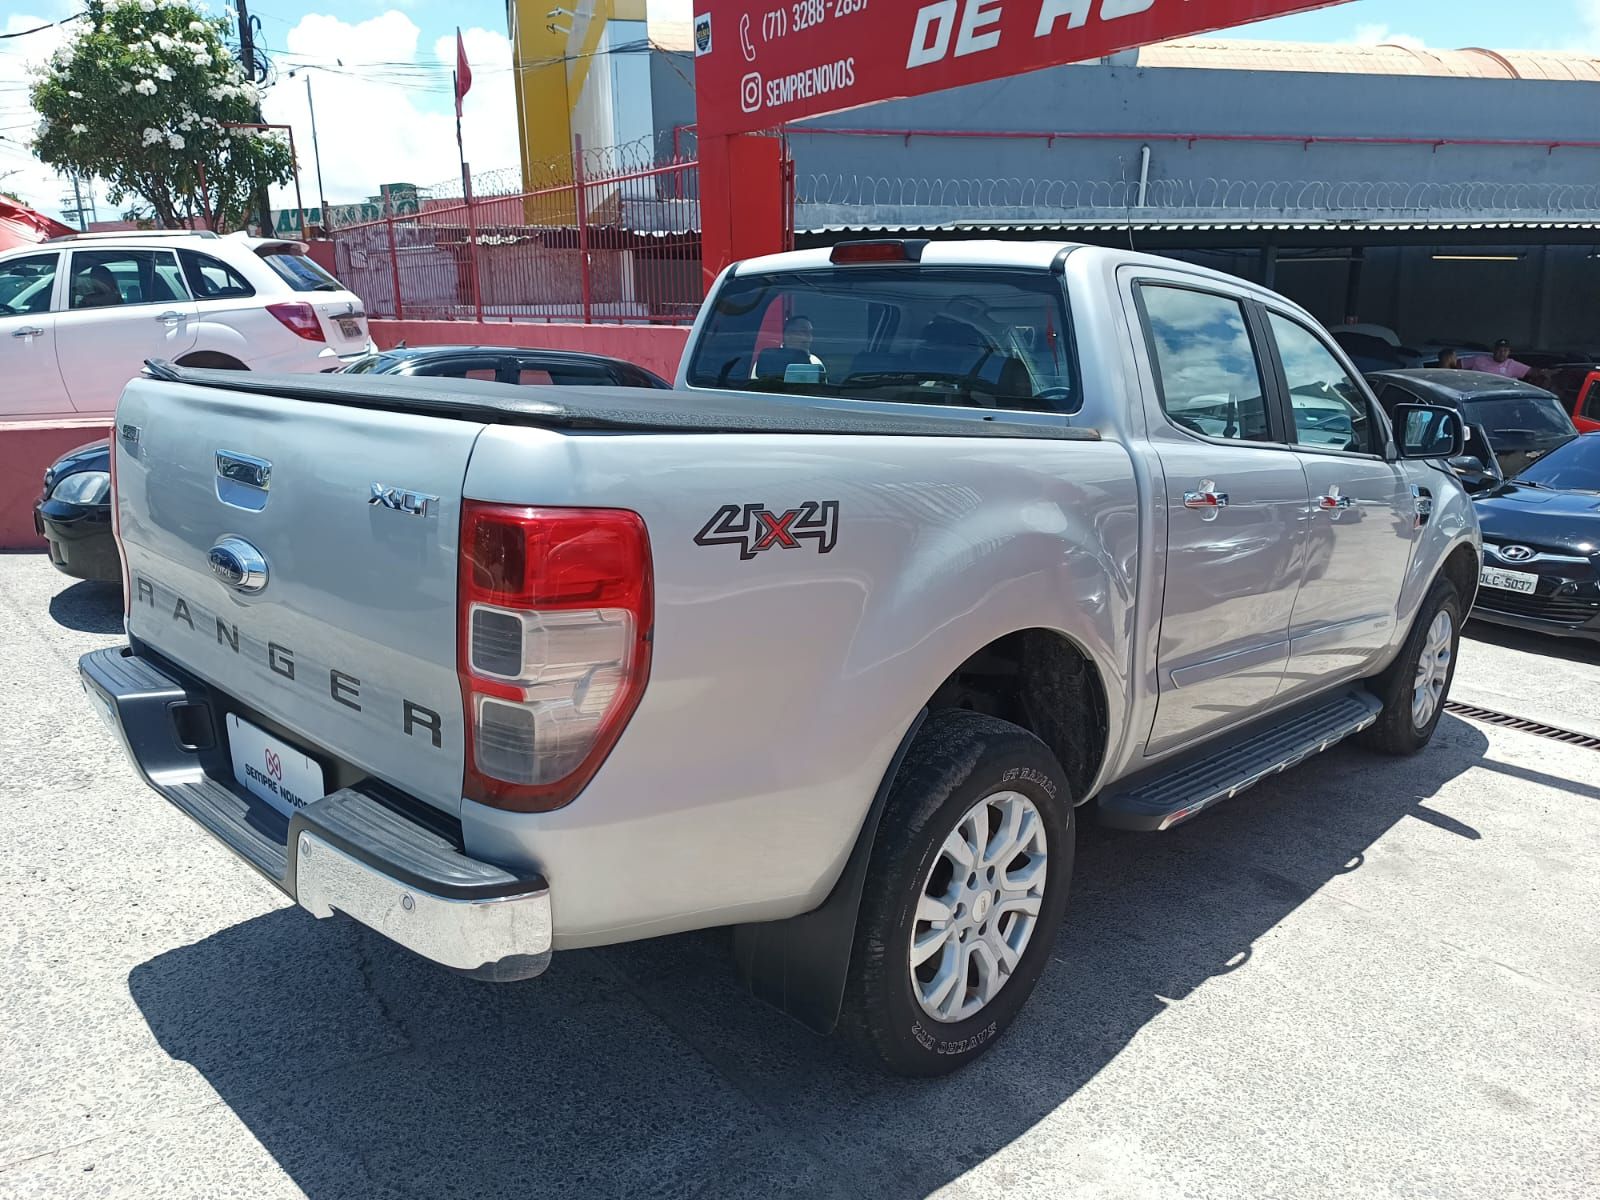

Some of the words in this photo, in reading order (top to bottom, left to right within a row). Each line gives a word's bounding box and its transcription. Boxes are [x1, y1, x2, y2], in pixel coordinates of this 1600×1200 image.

[762, 7, 788, 42] (71)
[906, 0, 1004, 70] DE
[765, 57, 855, 108] SEMPRENOVOS
[368, 481, 440, 519] XLT
[136, 576, 442, 750] RANGER
[244, 762, 279, 795] SEMPRE
[1002, 767, 1020, 782] GT
[1019, 767, 1057, 800] RADIAL
